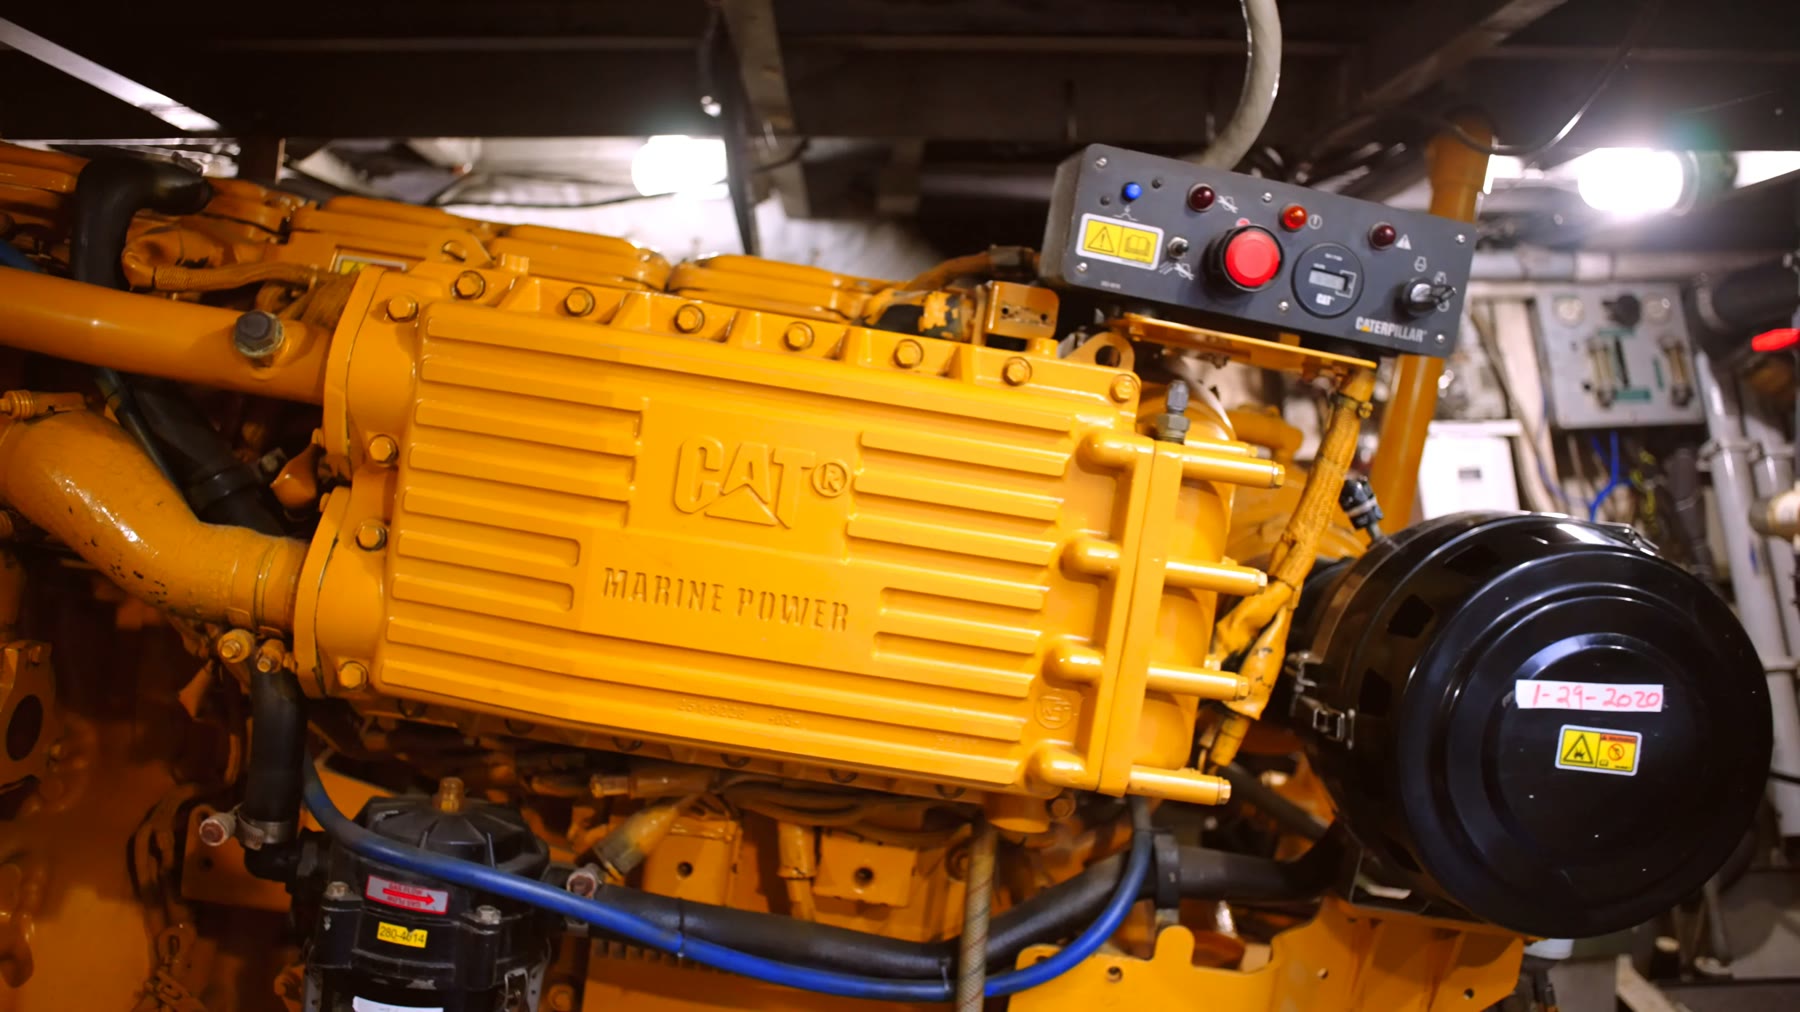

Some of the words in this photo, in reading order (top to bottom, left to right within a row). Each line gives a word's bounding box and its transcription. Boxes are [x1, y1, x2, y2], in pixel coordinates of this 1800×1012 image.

[602, 566, 725, 613] MARINE
[736, 586, 850, 632] POWER
[1532, 684, 1661, 711] 1-29-2020
